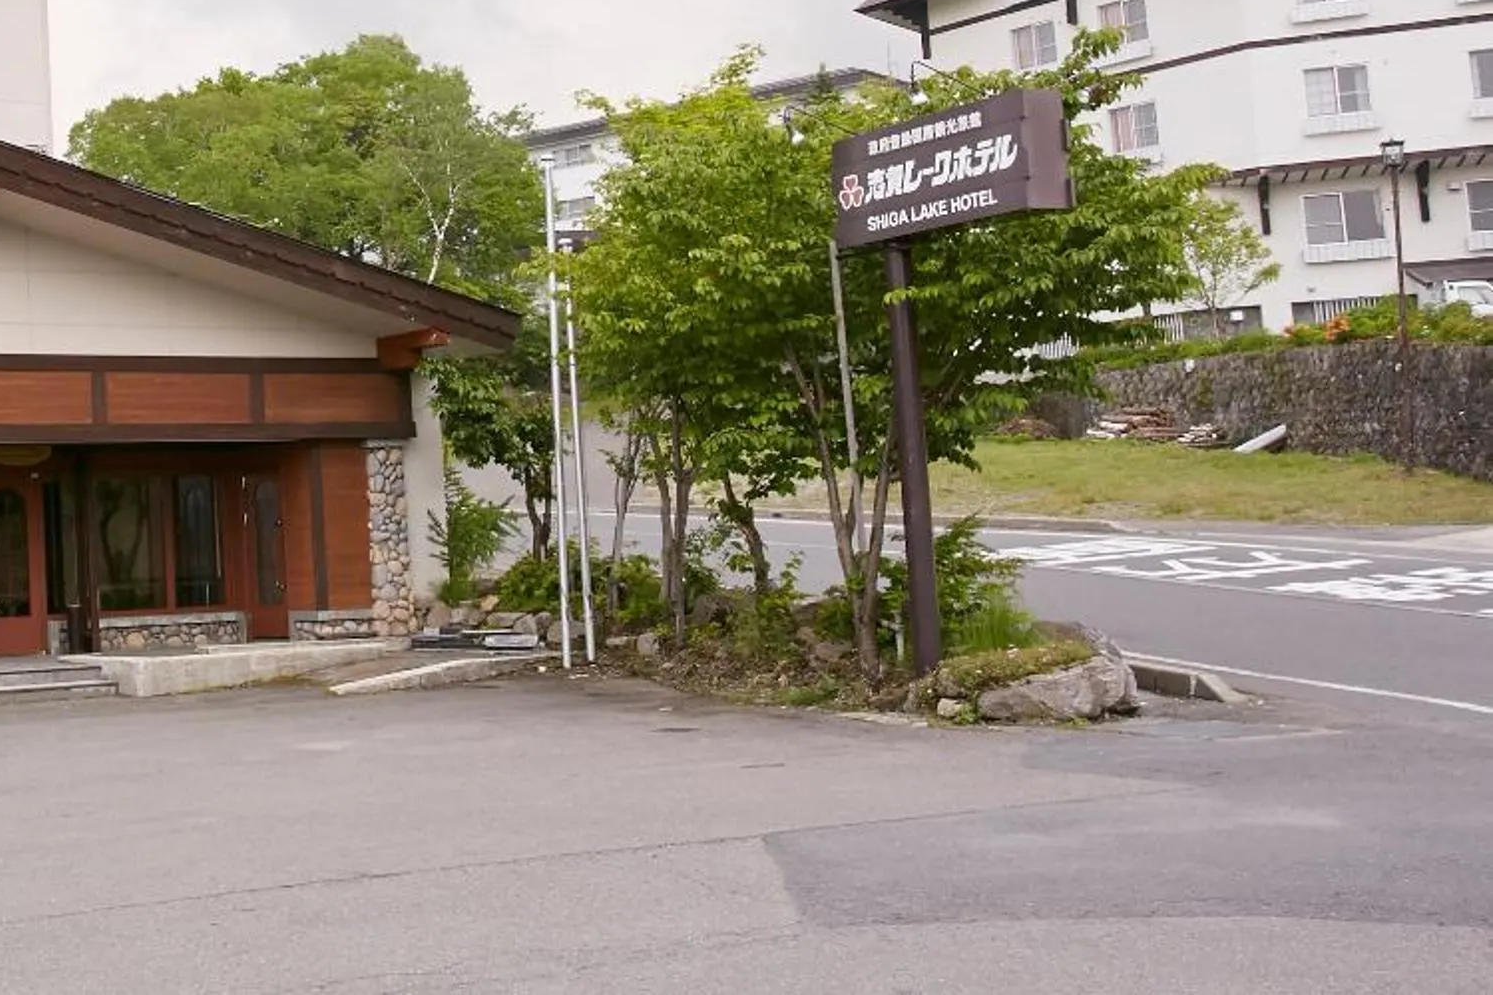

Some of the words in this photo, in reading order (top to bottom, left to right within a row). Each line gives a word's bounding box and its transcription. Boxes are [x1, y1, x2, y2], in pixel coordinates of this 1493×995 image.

[864, 134, 1018, 204] 志賀レークホテル
[867, 208, 909, 232] SHIGA
[911, 201, 948, 222] LAKE
[950, 188, 998, 214] HOTEL
